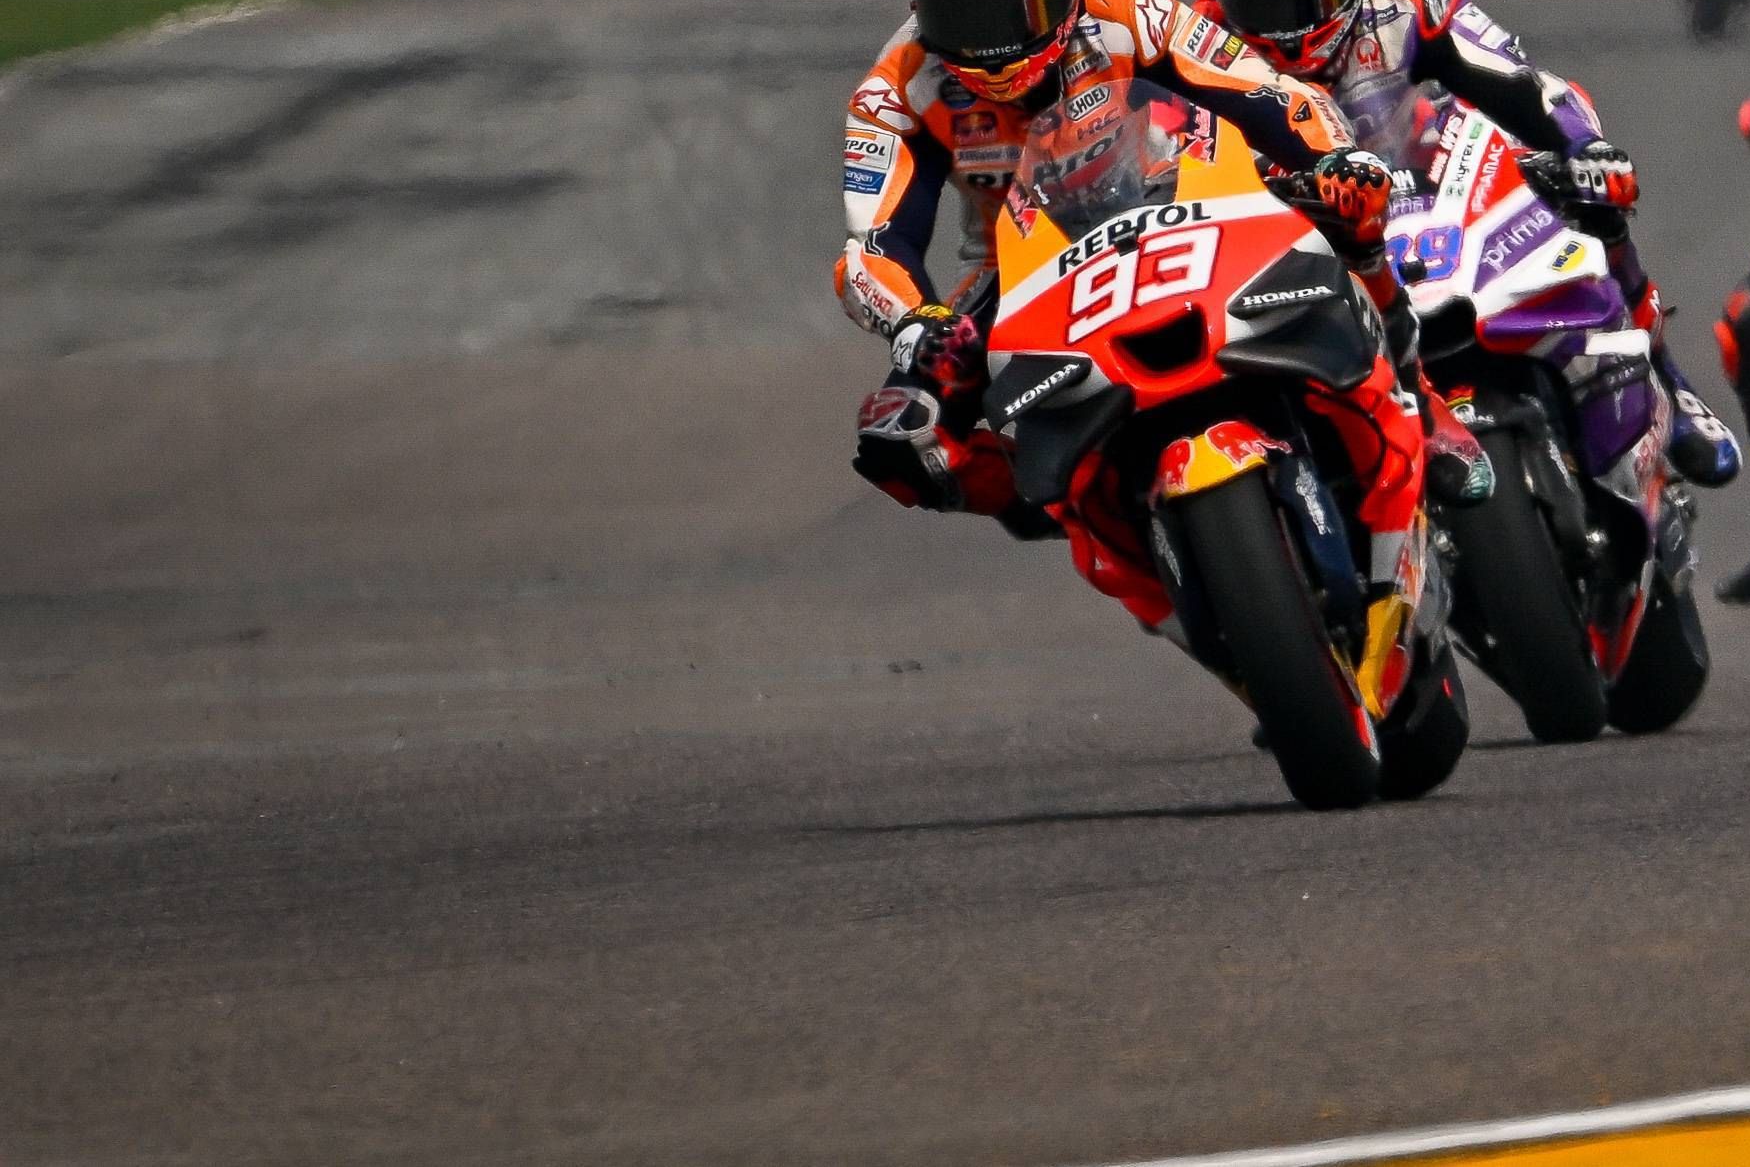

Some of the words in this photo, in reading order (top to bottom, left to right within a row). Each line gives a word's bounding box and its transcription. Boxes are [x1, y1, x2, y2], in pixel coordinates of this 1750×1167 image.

[1070, 88, 1107, 118] SHOEI
[1058, 202, 1212, 277] REPSOL
[1481, 209, 1554, 274] prima
[1067, 224, 1222, 345] 93
[1242, 285, 1336, 306] HONDA
[1004, 363, 1080, 415] HONDA
